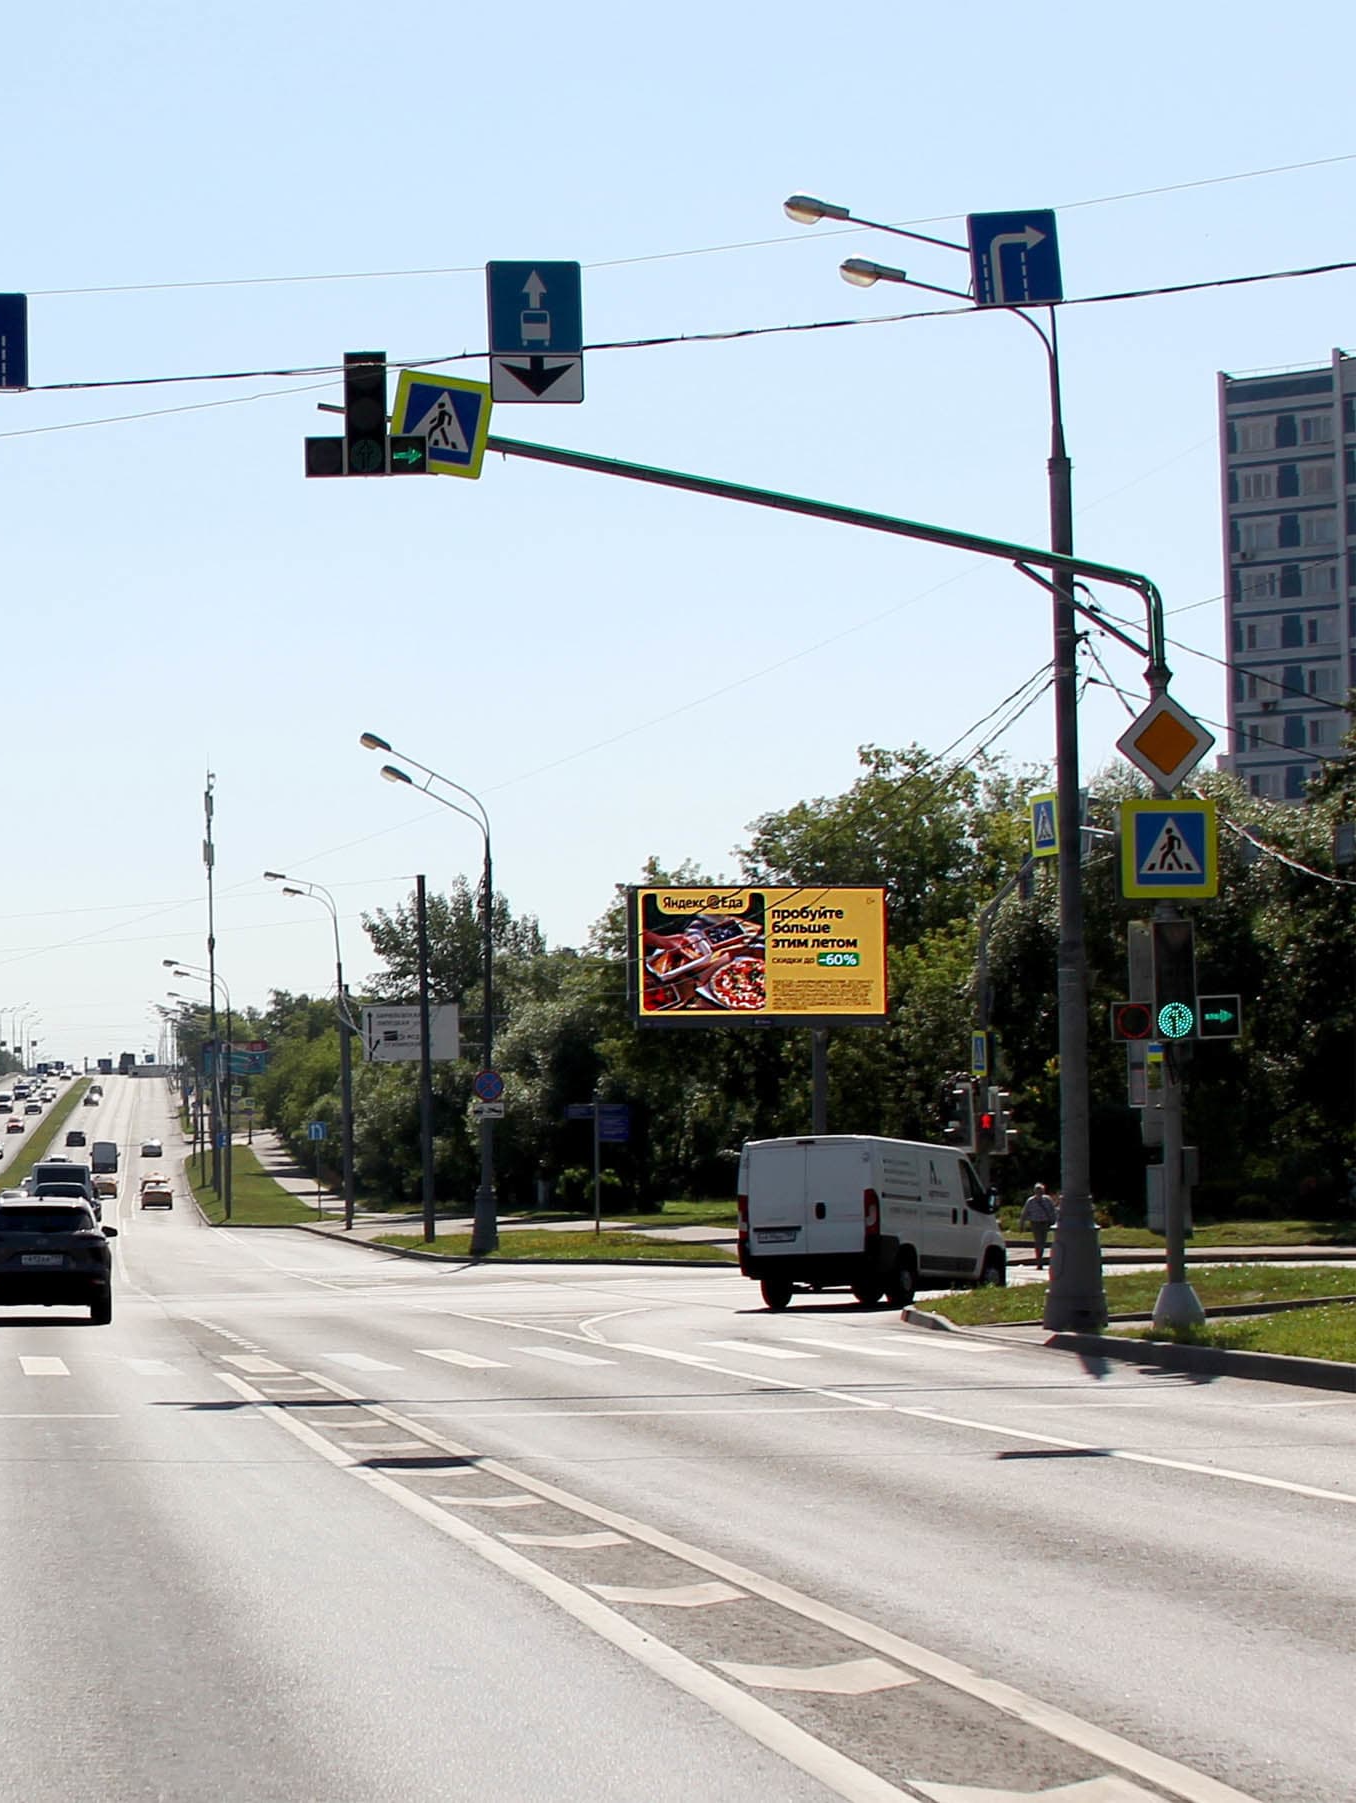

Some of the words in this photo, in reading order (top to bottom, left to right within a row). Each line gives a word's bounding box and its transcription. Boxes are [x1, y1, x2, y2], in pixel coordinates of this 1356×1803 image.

[663, 896, 705, 909] Яндекс
[721, 896, 743, 909] Еда
[771, 906, 844, 921] пробуйте
[771, 921, 831, 934] больше
[771, 938, 808, 948] этим
[811, 938, 858, 948] летом
[771, 957, 803, 965] скидки
[803, 957, 815, 965] до
[818, 953, 857, 965] -60%
